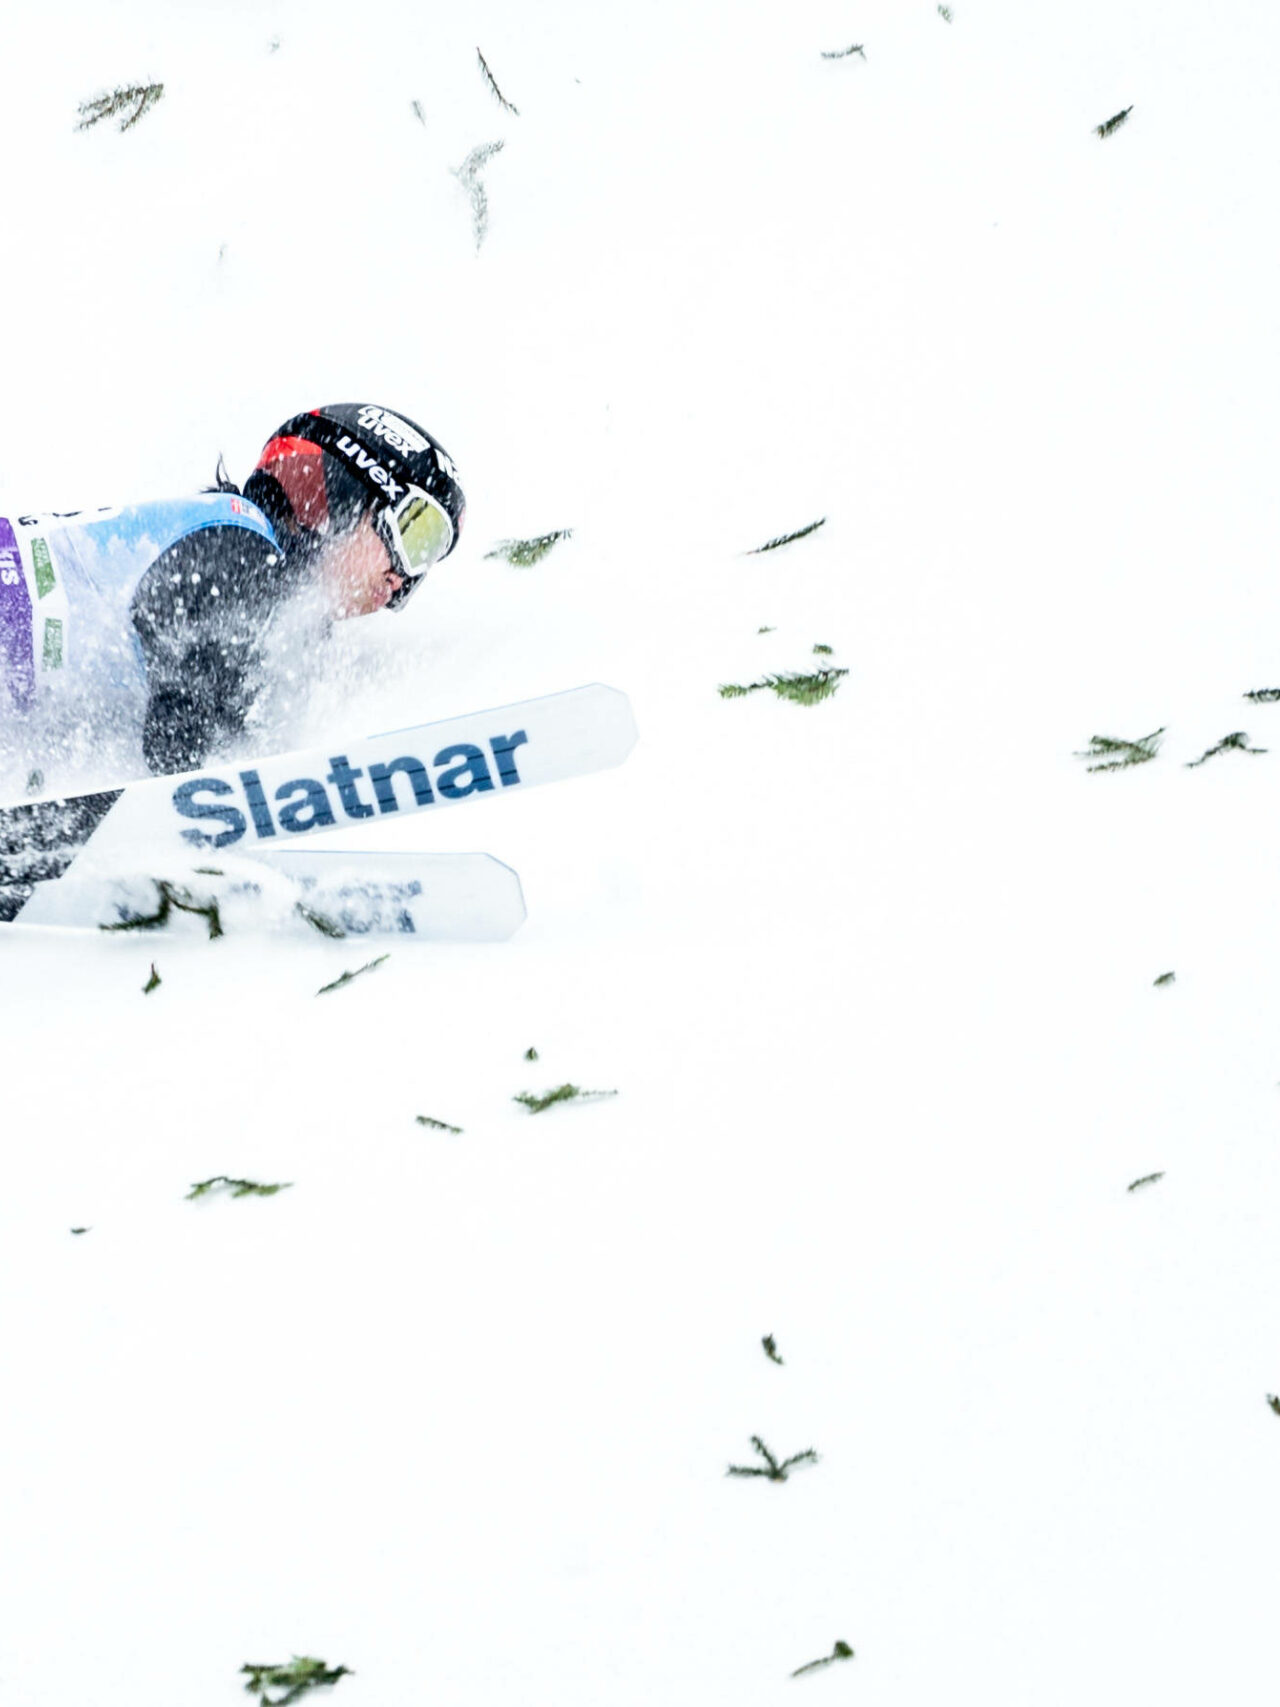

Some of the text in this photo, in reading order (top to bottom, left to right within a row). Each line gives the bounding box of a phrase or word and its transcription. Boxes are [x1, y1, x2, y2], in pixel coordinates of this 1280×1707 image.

[336, 436, 404, 500] uvex
[357, 415, 417, 459] uvex
[172, 729, 529, 848] Slatnar
